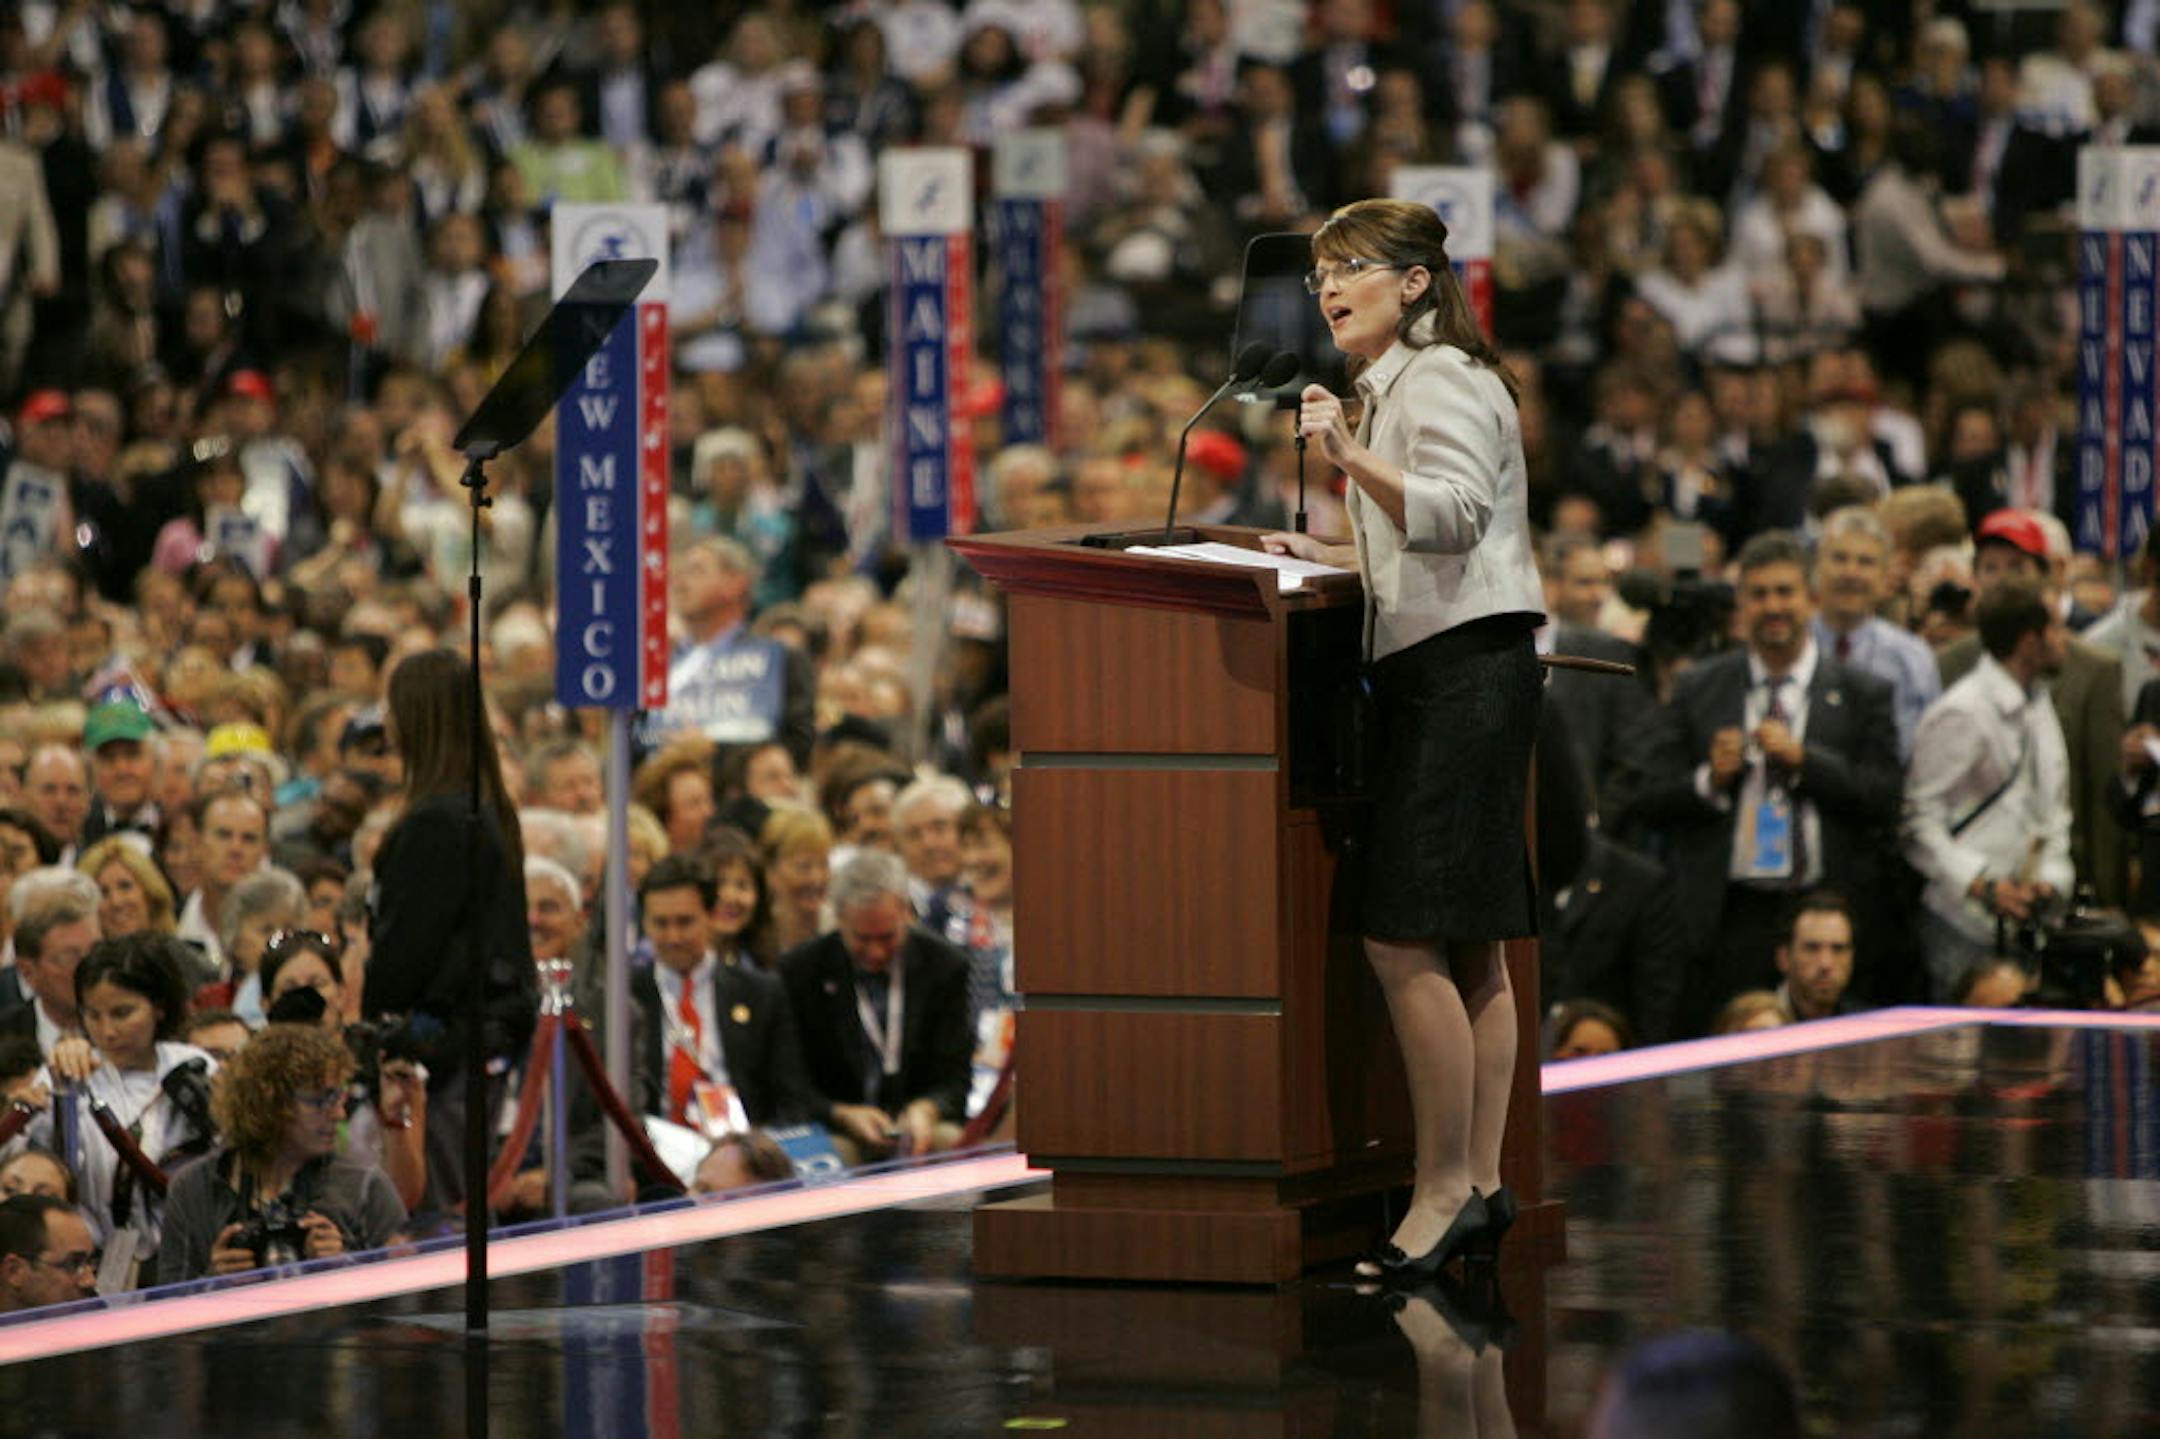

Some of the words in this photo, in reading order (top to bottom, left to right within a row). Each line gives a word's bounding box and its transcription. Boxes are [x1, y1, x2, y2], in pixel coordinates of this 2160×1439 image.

[903, 239, 943, 507] MAINE
[2124, 236, 2152, 547] NEVADA
[580, 454, 616, 700] MEXICO
